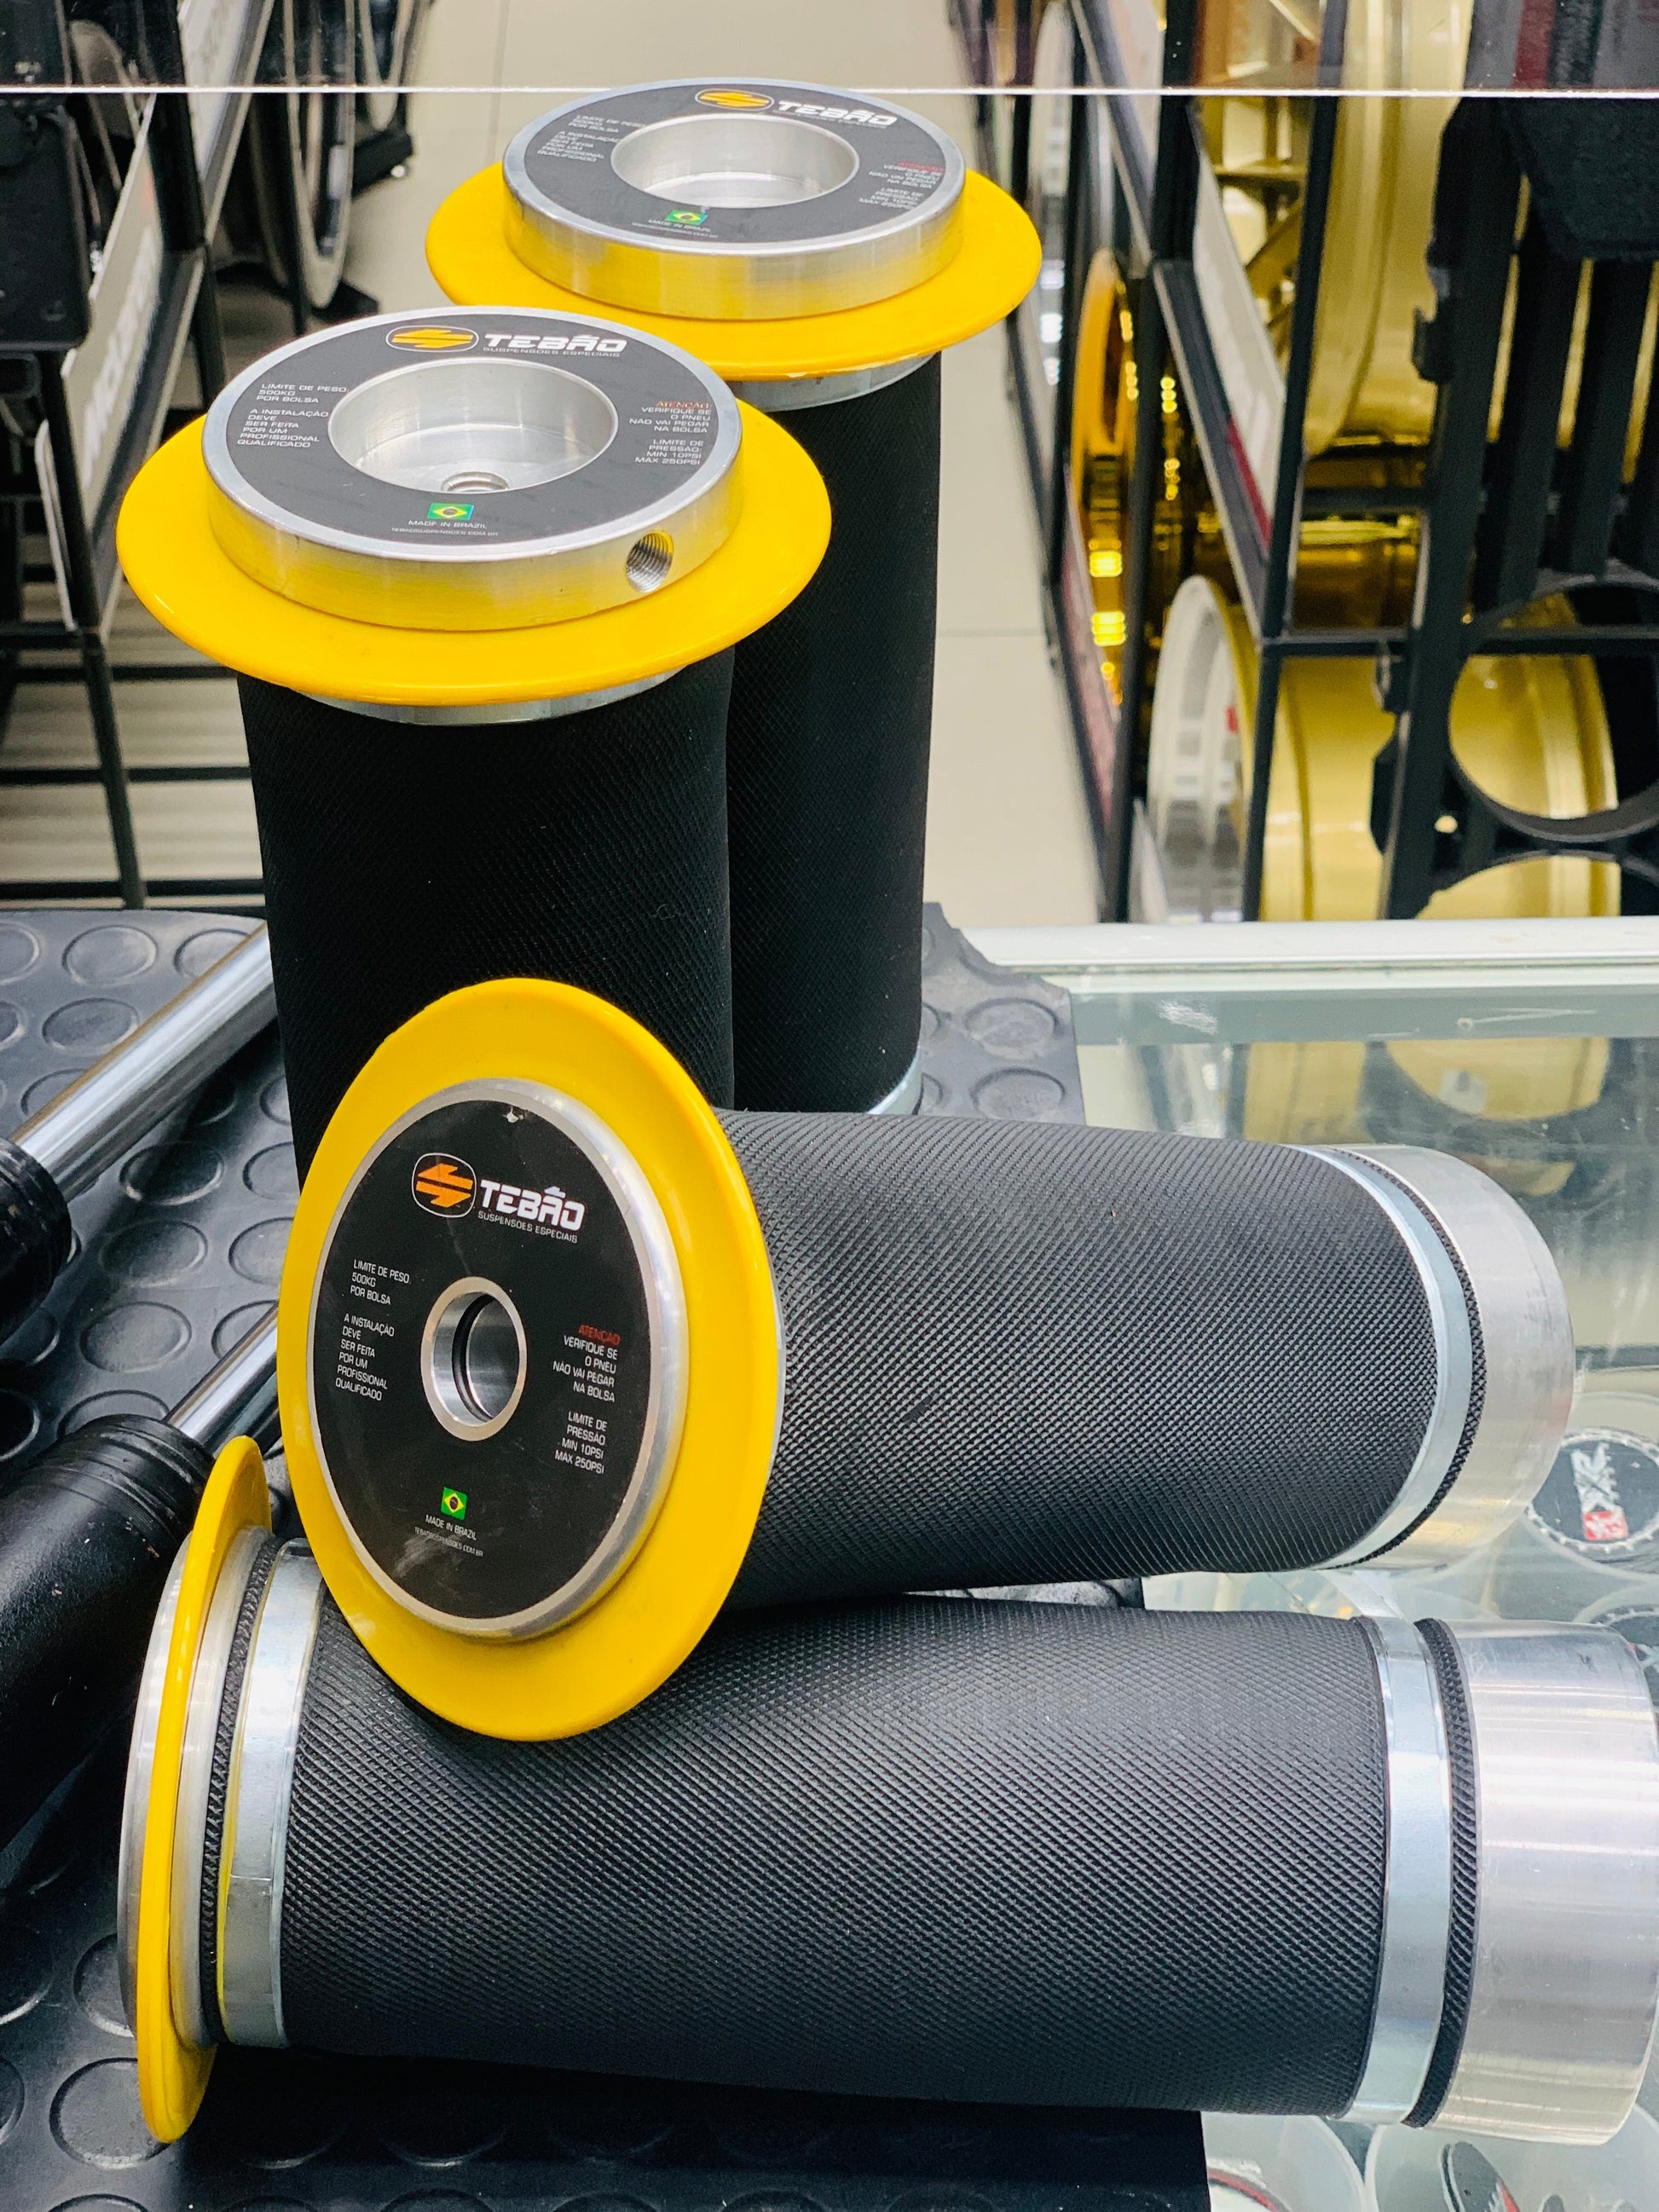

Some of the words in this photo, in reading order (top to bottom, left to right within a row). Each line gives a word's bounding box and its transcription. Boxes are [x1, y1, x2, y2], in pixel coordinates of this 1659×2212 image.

[240, 433, 320, 442] PROFISSIONAL
[535, 1226, 577, 1244] ESPECIAIS
[354, 1260, 376, 1273] LIMITE
[378, 1266, 387, 1278] DE
[352, 1272, 376, 1287] 500KG
[350, 1285, 365, 1297] POR
[367, 1290, 390, 1305] BOLSA
[343, 1326, 361, 1340] DEVE
[344, 1314, 349, 1322] A
[351, 1315, 394, 1337] INSTALAÇÃO
[341, 1339, 355, 1351] SER
[357, 1343, 375, 1357] FEITA
[564, 1335, 604, 1355] VERIFIQUE
[607, 1348, 618, 1360] SE
[339, 1352, 353, 1364] POR
[356, 1357, 367, 1368] UM
[585, 1356, 592, 1367] O
[594, 1358, 616, 1374] PNEU
[338, 1365, 388, 1389] PROFISSIONAL
[553, 1360, 570, 1375] NÃO
[573, 1367, 585, 1379] VAI
[587, 1372, 615, 1388] PEGAR
[336, 1377, 382, 1401] QUALIFICADO
[573, 1381, 585, 1394] NA
[587, 1386, 615, 1402] BOLSA
[569, 1411, 593, 1428] LIMITE
[596, 1419, 607, 1431] DE
[562, 1437, 577, 1452] MIN
[581, 1443, 604, 1459] 10PSI
[575, 1458, 604, 1474] 250PSI
[425, 1515, 444, 1528] MADE
[446, 1522, 453, 1531] IN
[454, 1525, 477, 1540] BRAZIL
